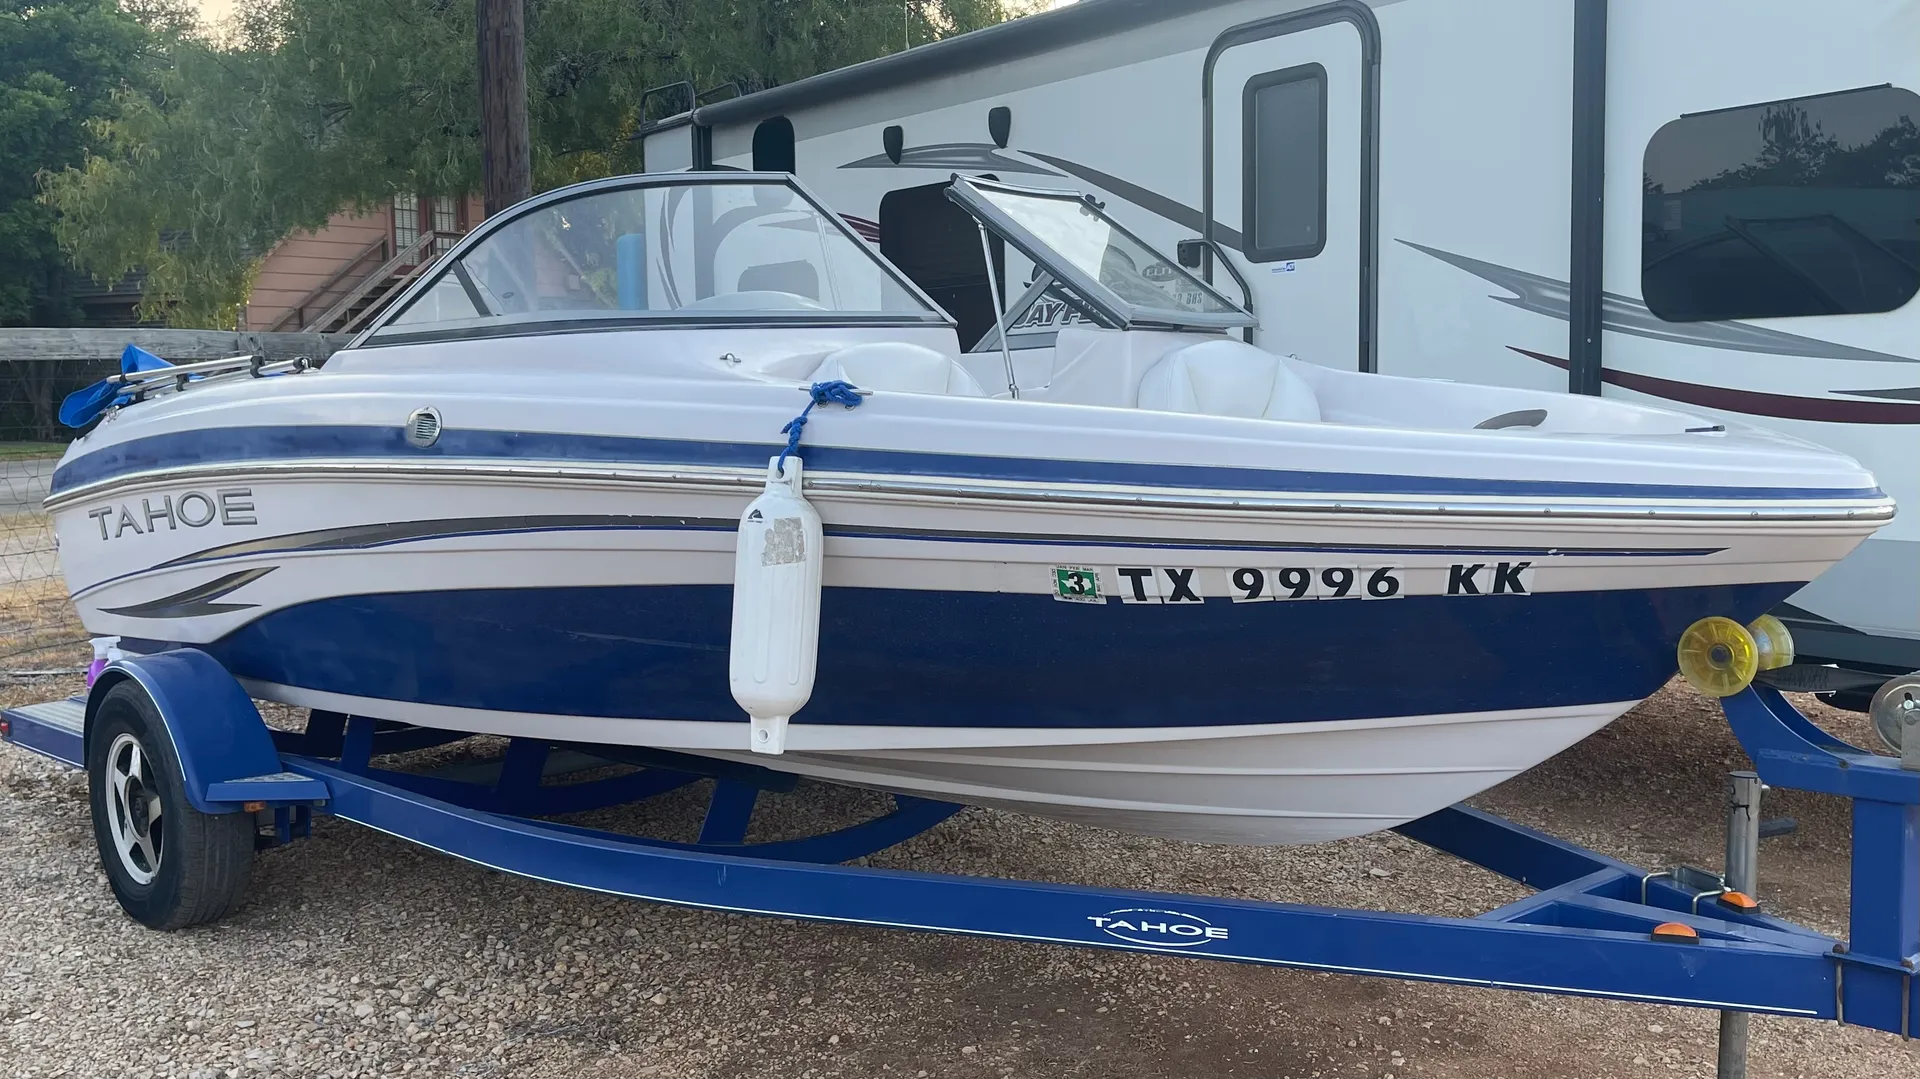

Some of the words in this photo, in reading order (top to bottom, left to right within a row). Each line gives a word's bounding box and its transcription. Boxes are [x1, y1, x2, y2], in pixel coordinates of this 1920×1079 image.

[88, 487, 258, 541] TAHOE
[1068, 572, 1085, 595] 3
[1118, 568, 1202, 601] TX
[1232, 567, 1400, 600] 9996
[1447, 562, 1532, 595] KK
[1087, 916, 1229, 940] TAHOE
